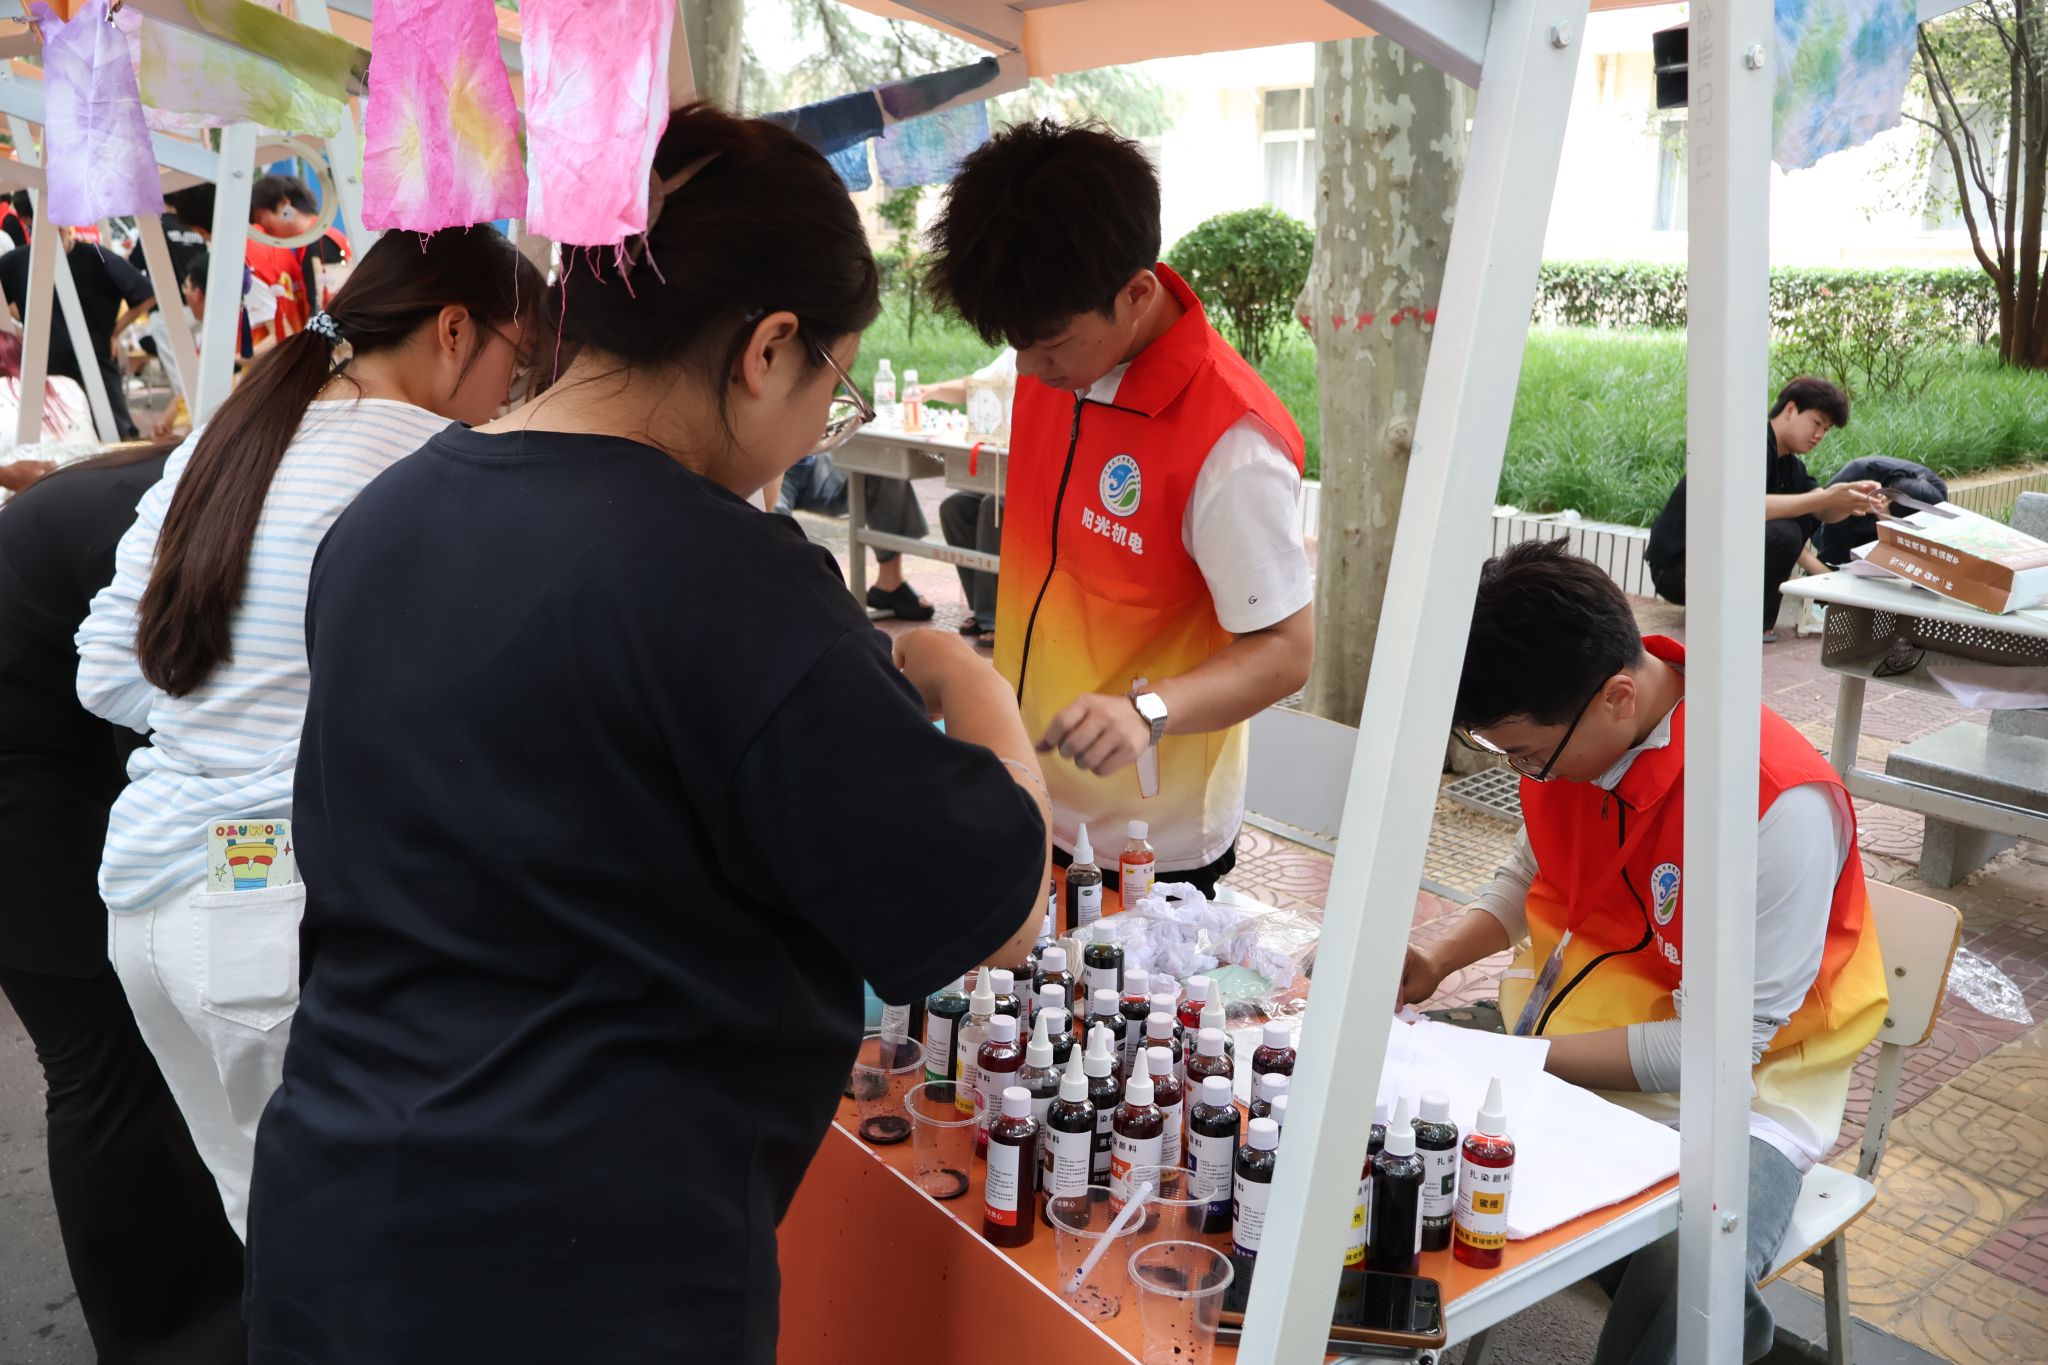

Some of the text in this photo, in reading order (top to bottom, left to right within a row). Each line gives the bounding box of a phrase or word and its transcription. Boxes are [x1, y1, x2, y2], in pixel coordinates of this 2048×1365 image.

[1081, 506, 1144, 555] 阳光机电
[215, 823, 286, 837] TOMATO
[1469, 1168, 1512, 1184] 扎染颜料
[1479, 1198, 1499, 1209] 蜜橙
